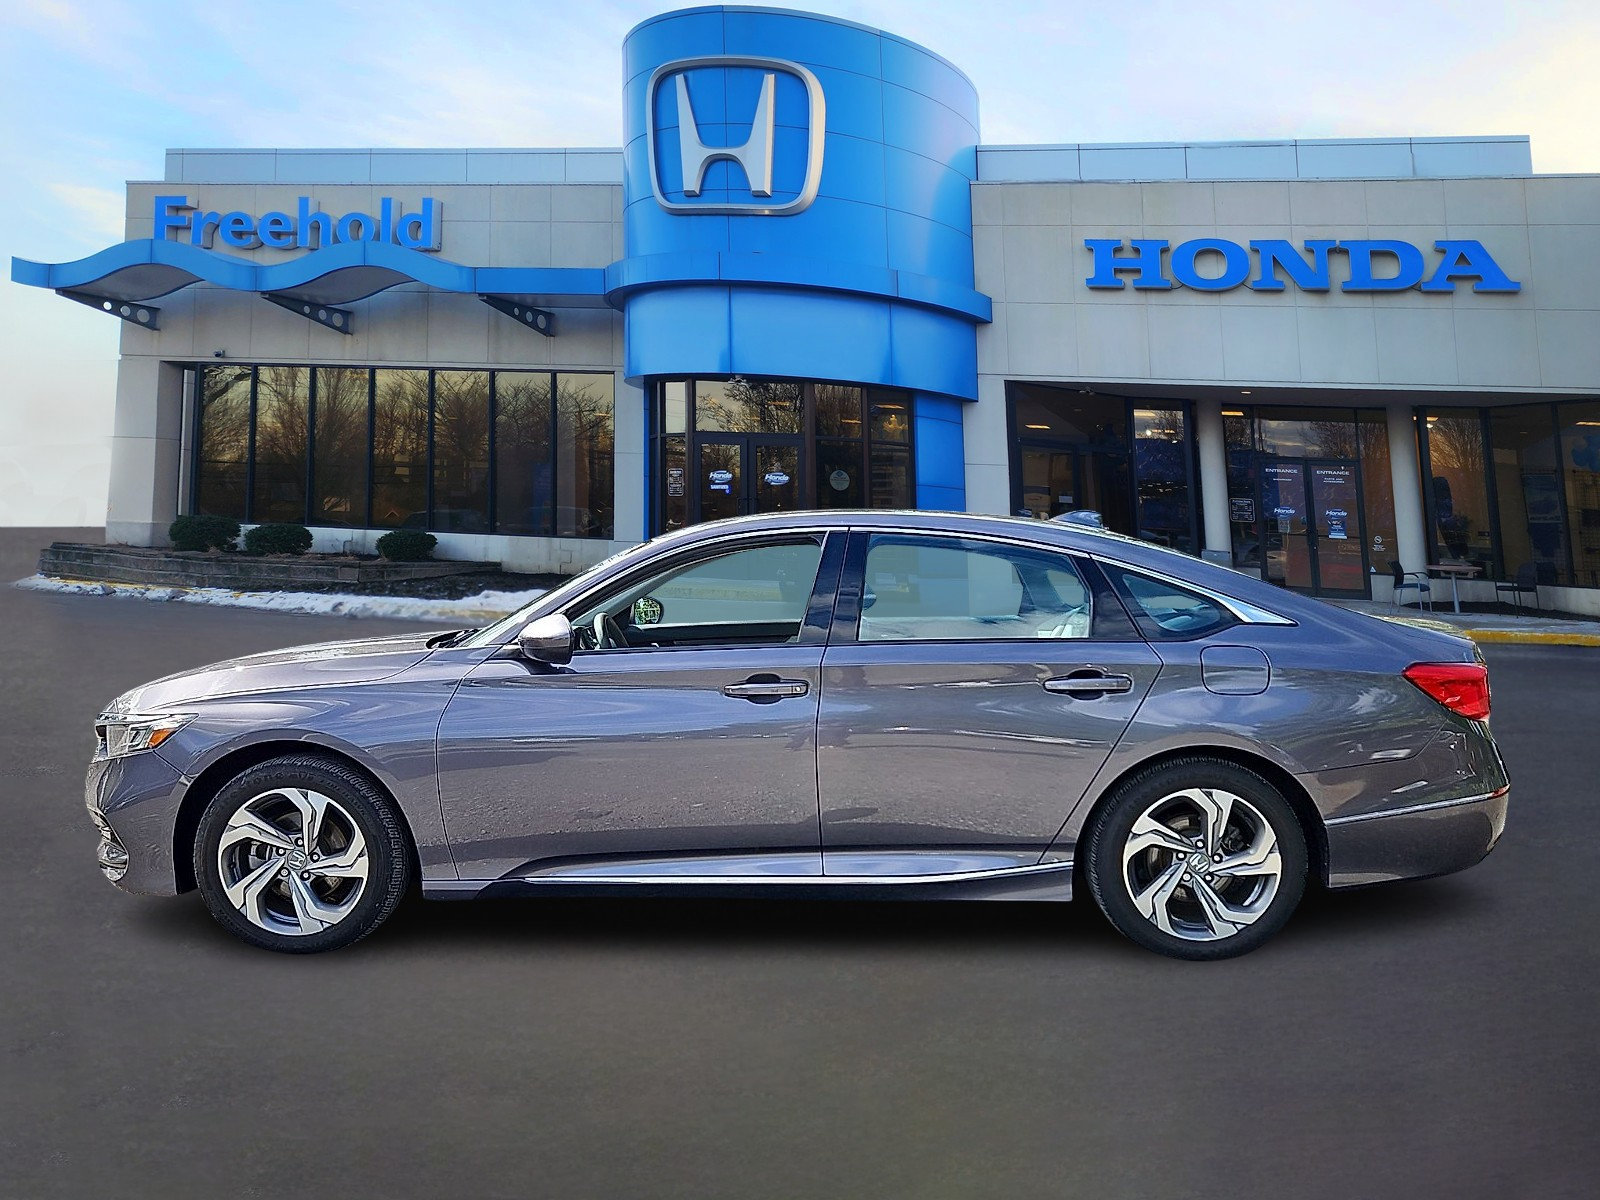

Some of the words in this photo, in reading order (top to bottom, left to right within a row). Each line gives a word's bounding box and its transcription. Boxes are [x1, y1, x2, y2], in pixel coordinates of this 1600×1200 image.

[154, 195, 438, 249] Freehold
[1084, 238, 1521, 293] HONDA
[709, 472, 733, 480] Honda
